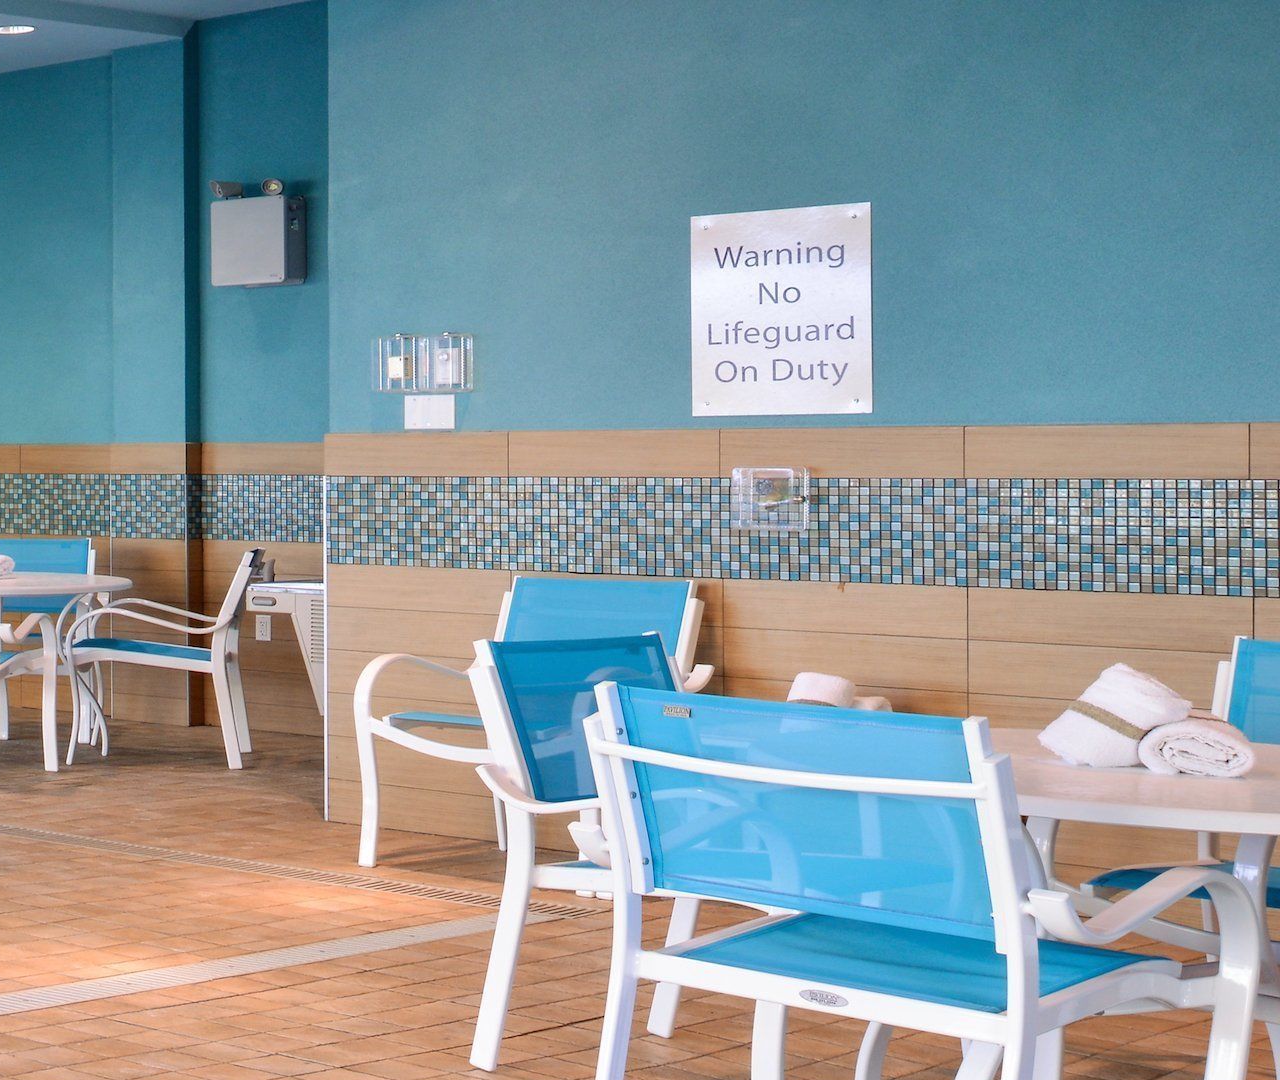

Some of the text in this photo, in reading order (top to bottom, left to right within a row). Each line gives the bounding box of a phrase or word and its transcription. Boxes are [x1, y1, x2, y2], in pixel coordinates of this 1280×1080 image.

[713, 241, 846, 269] Warning
[758, 281, 802, 305] No
[707, 315, 856, 350] Lifeguard
[714, 358, 849, 387] On Duty
